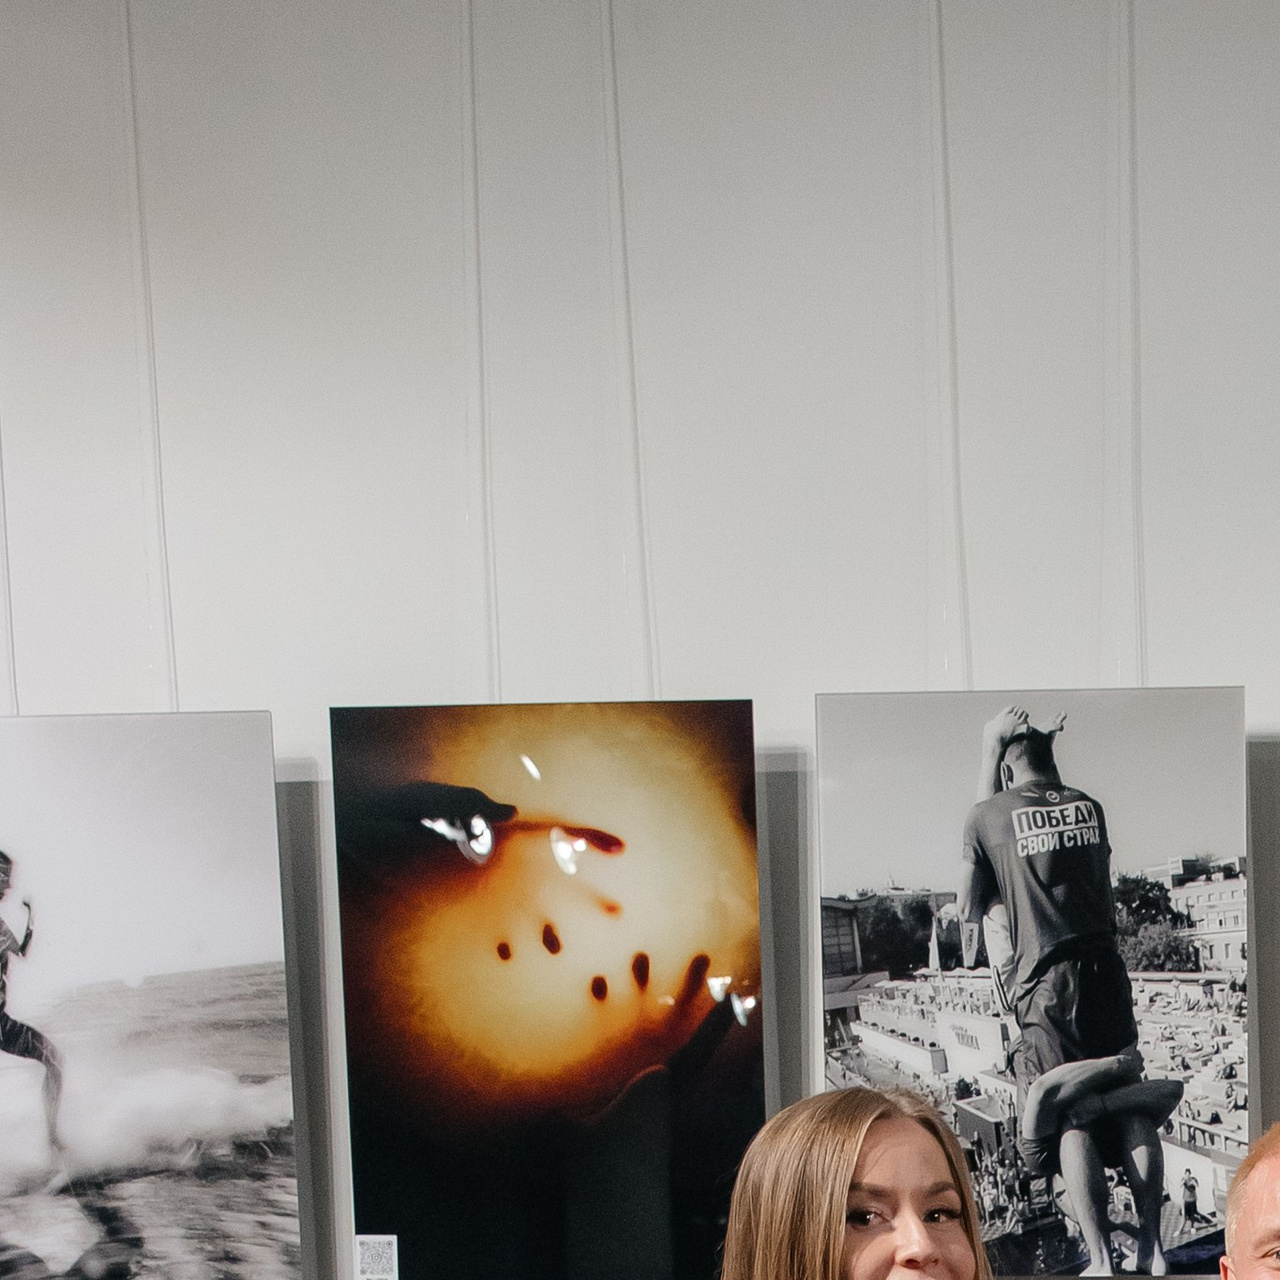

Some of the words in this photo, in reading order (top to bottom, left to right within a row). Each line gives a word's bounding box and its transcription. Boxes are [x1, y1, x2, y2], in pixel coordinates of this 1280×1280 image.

[1016, 803, 1097, 833] ПОБЕДИ
[1017, 832, 1060, 858] СВОЙ
[1063, 827, 1101, 848] СТРАХ
